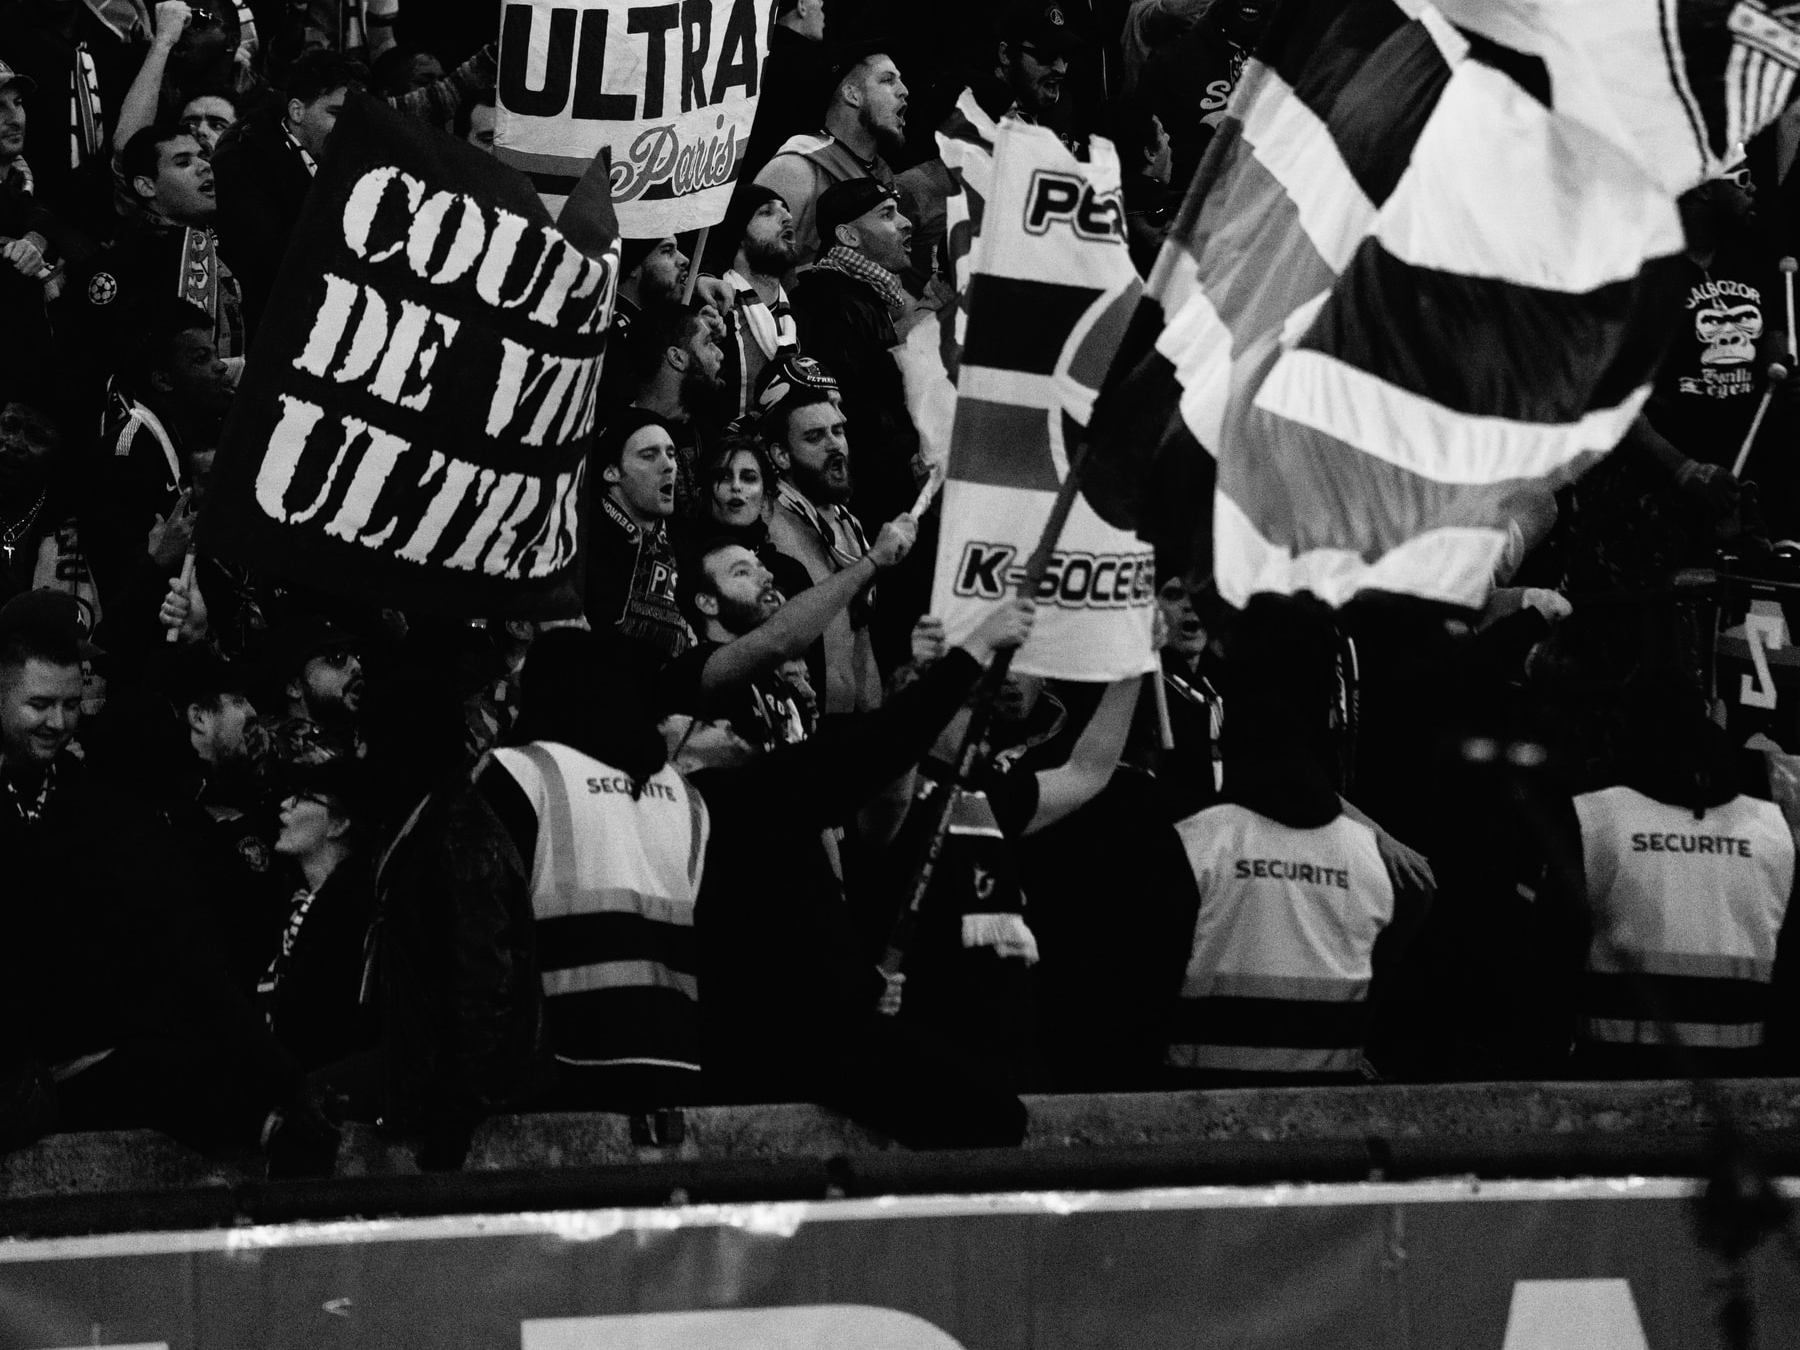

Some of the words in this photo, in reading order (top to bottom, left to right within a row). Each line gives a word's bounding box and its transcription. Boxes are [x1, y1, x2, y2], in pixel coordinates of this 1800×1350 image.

[611, 113, 736, 204] Paris
[292, 273, 460, 412] DE
[256, 393, 586, 579] ULTRA
[1235, 859, 1349, 890] SECURITE
[1632, 833, 1753, 858] SECURITE
